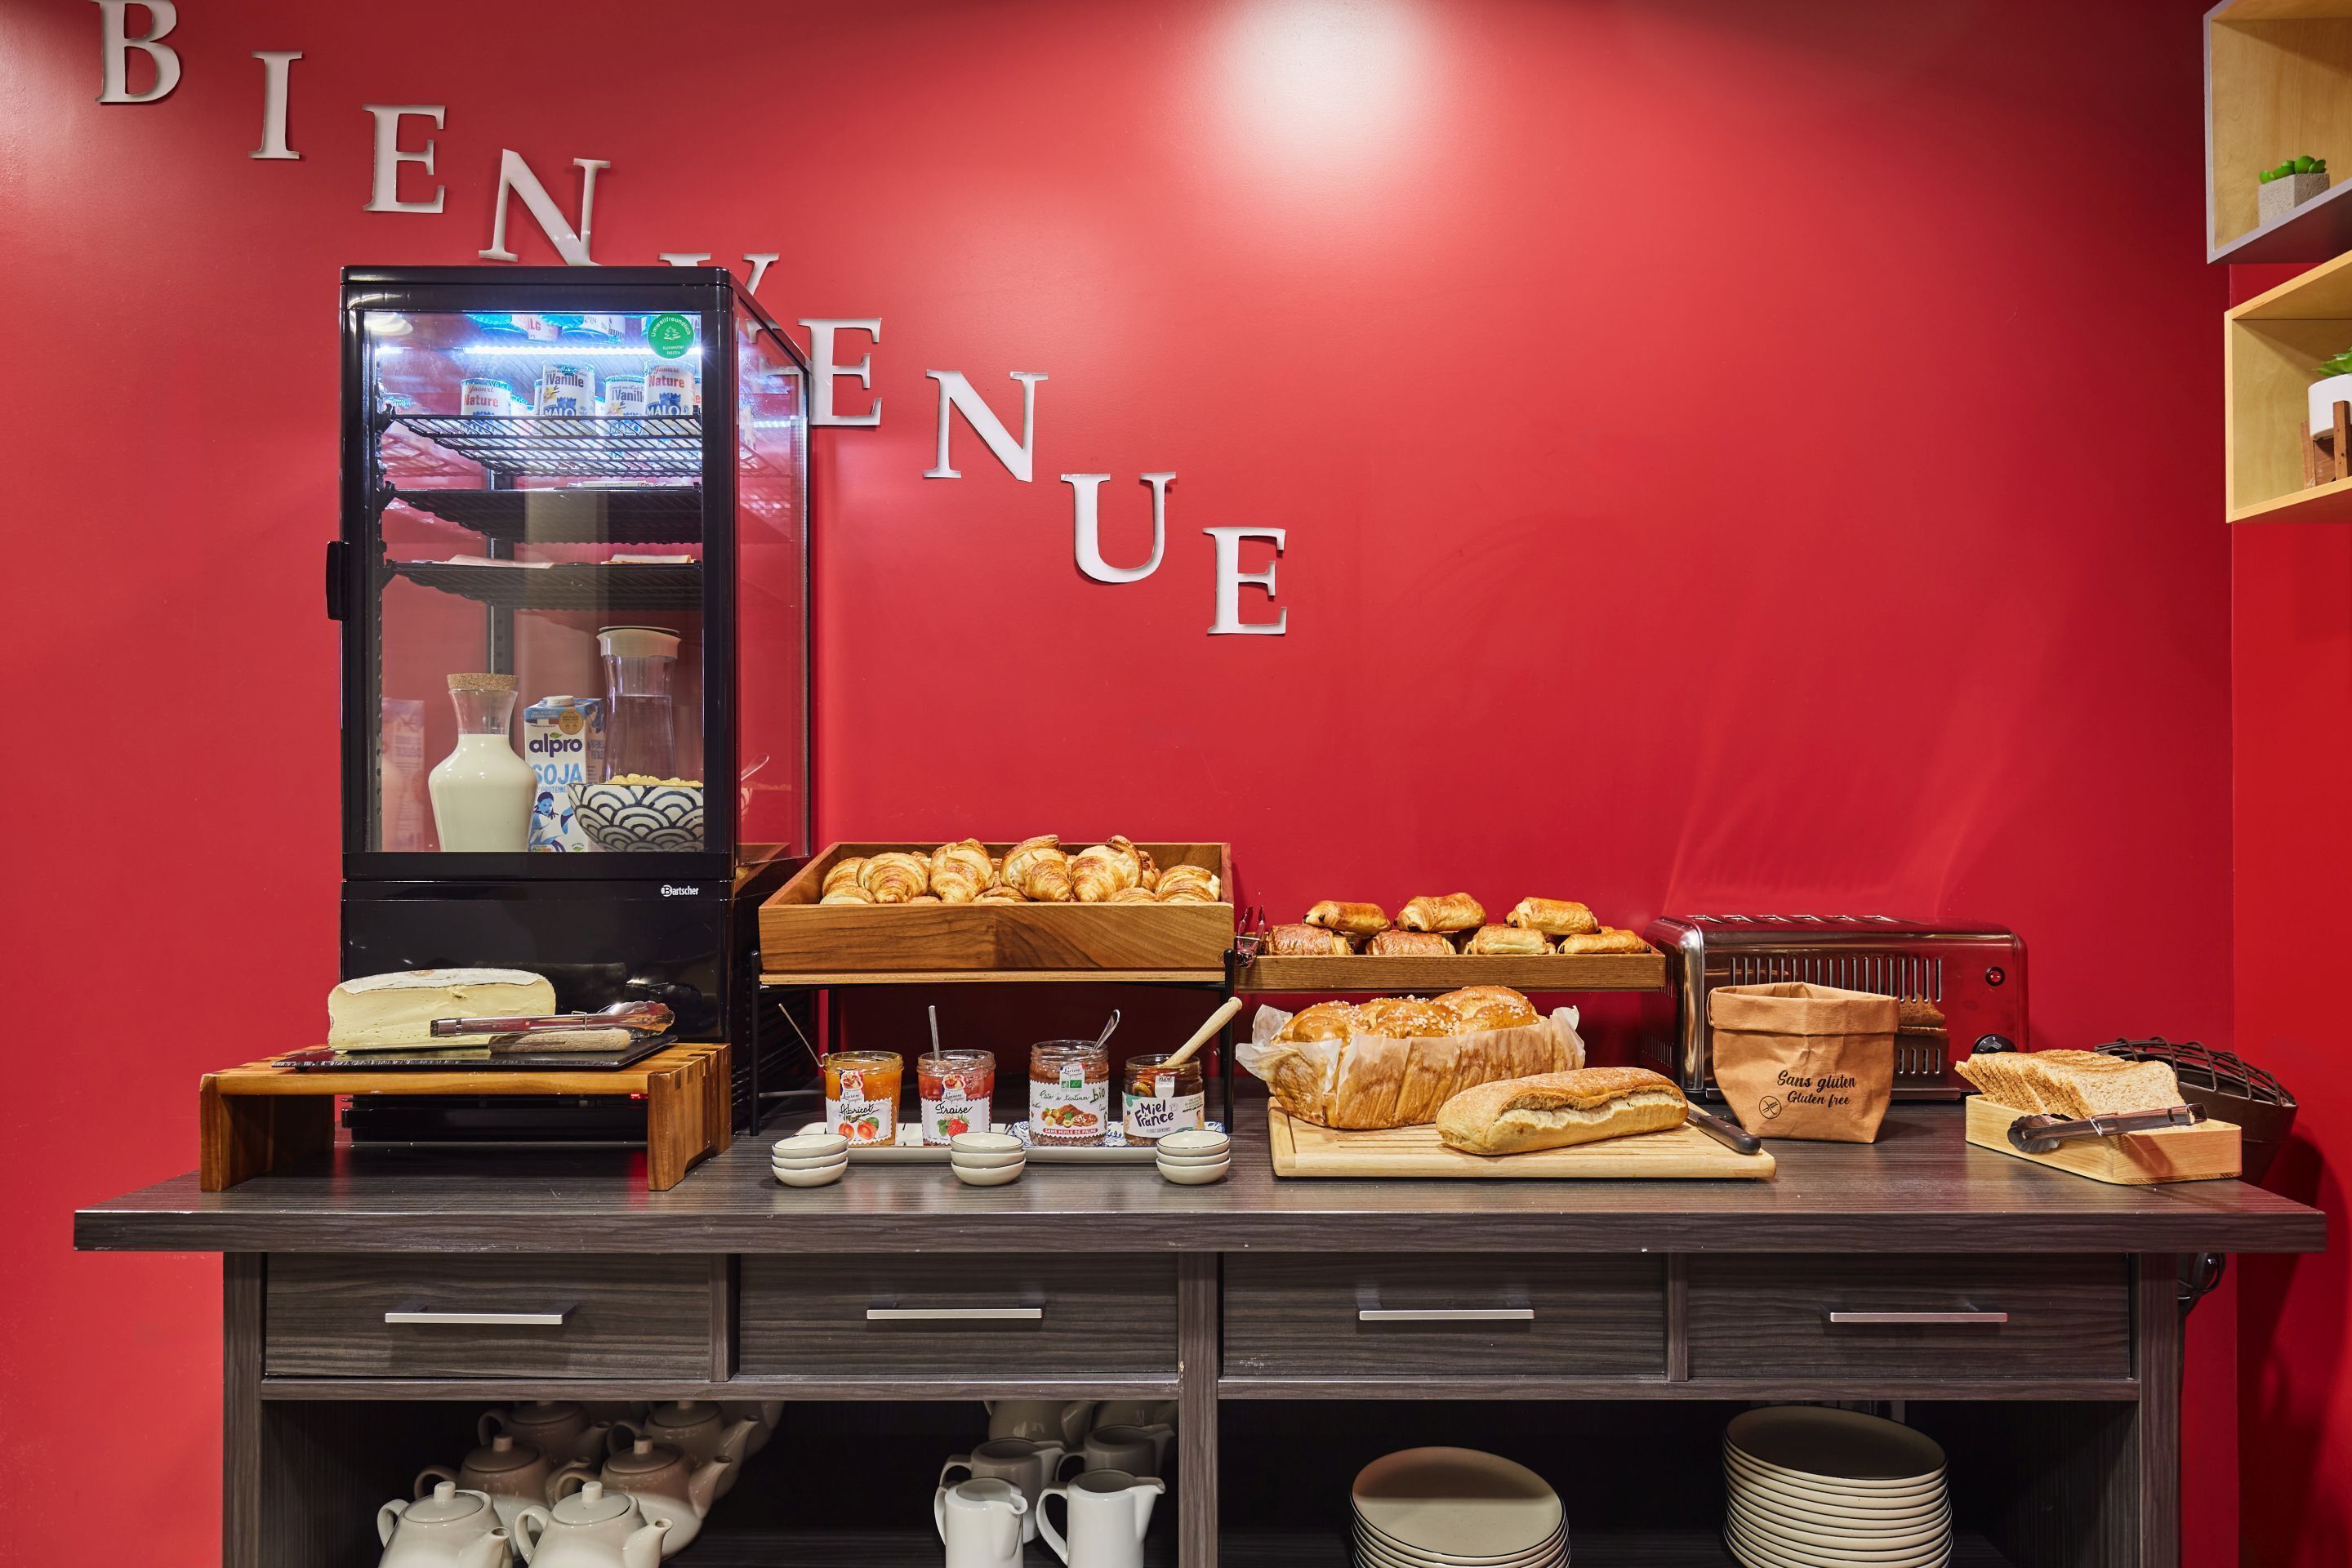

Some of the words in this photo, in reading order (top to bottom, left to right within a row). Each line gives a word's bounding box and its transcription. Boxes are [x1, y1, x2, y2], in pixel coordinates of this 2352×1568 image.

[650, 317, 692, 337] Umweltfreundlich
[648, 376, 684, 388] Nature
[464, 394, 499, 408] Nature
[645, 405, 679, 416] MALO
[529, 733, 583, 758] alpro
[532, 763, 583, 785] SOJA
[661, 884, 699, 897] Bartscher
[1777, 1070, 1812, 1087] Sans
[1816, 1075, 1856, 1093] gluten
[1089, 1087, 1106, 1104] bio
[1787, 1090, 1825, 1104] Gluten
[1828, 1094, 1850, 1107] free
[839, 1103, 875, 1121] Abricot
[935, 1100, 973, 1115] Fraise
[1140, 1098, 1166, 1115] Miel
[1134, 1111, 1174, 1127] France
